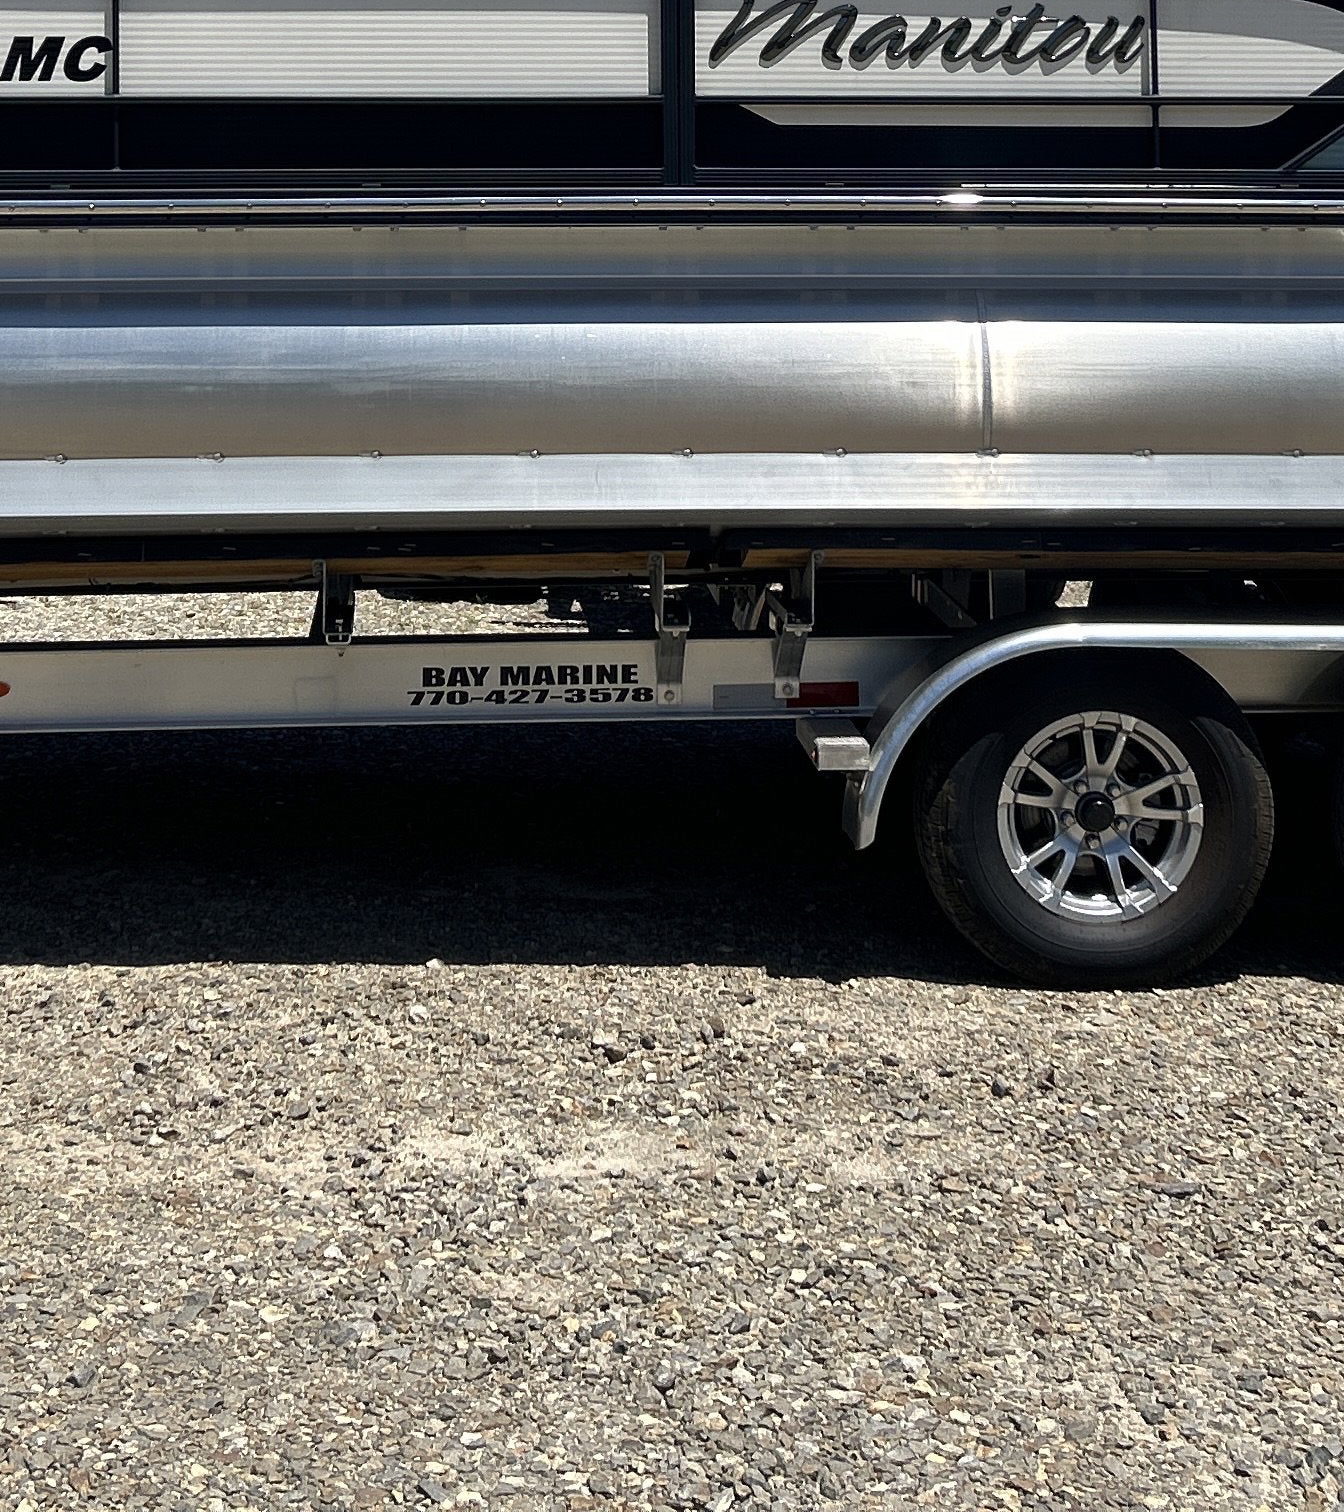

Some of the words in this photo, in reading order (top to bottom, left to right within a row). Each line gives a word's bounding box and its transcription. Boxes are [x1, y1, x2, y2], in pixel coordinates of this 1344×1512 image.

[0, 35, 114, 83] MC
[421, 666, 491, 688] BAY
[499, 664, 639, 686] MARINE
[406, 687, 654, 707] 770-427-3578
